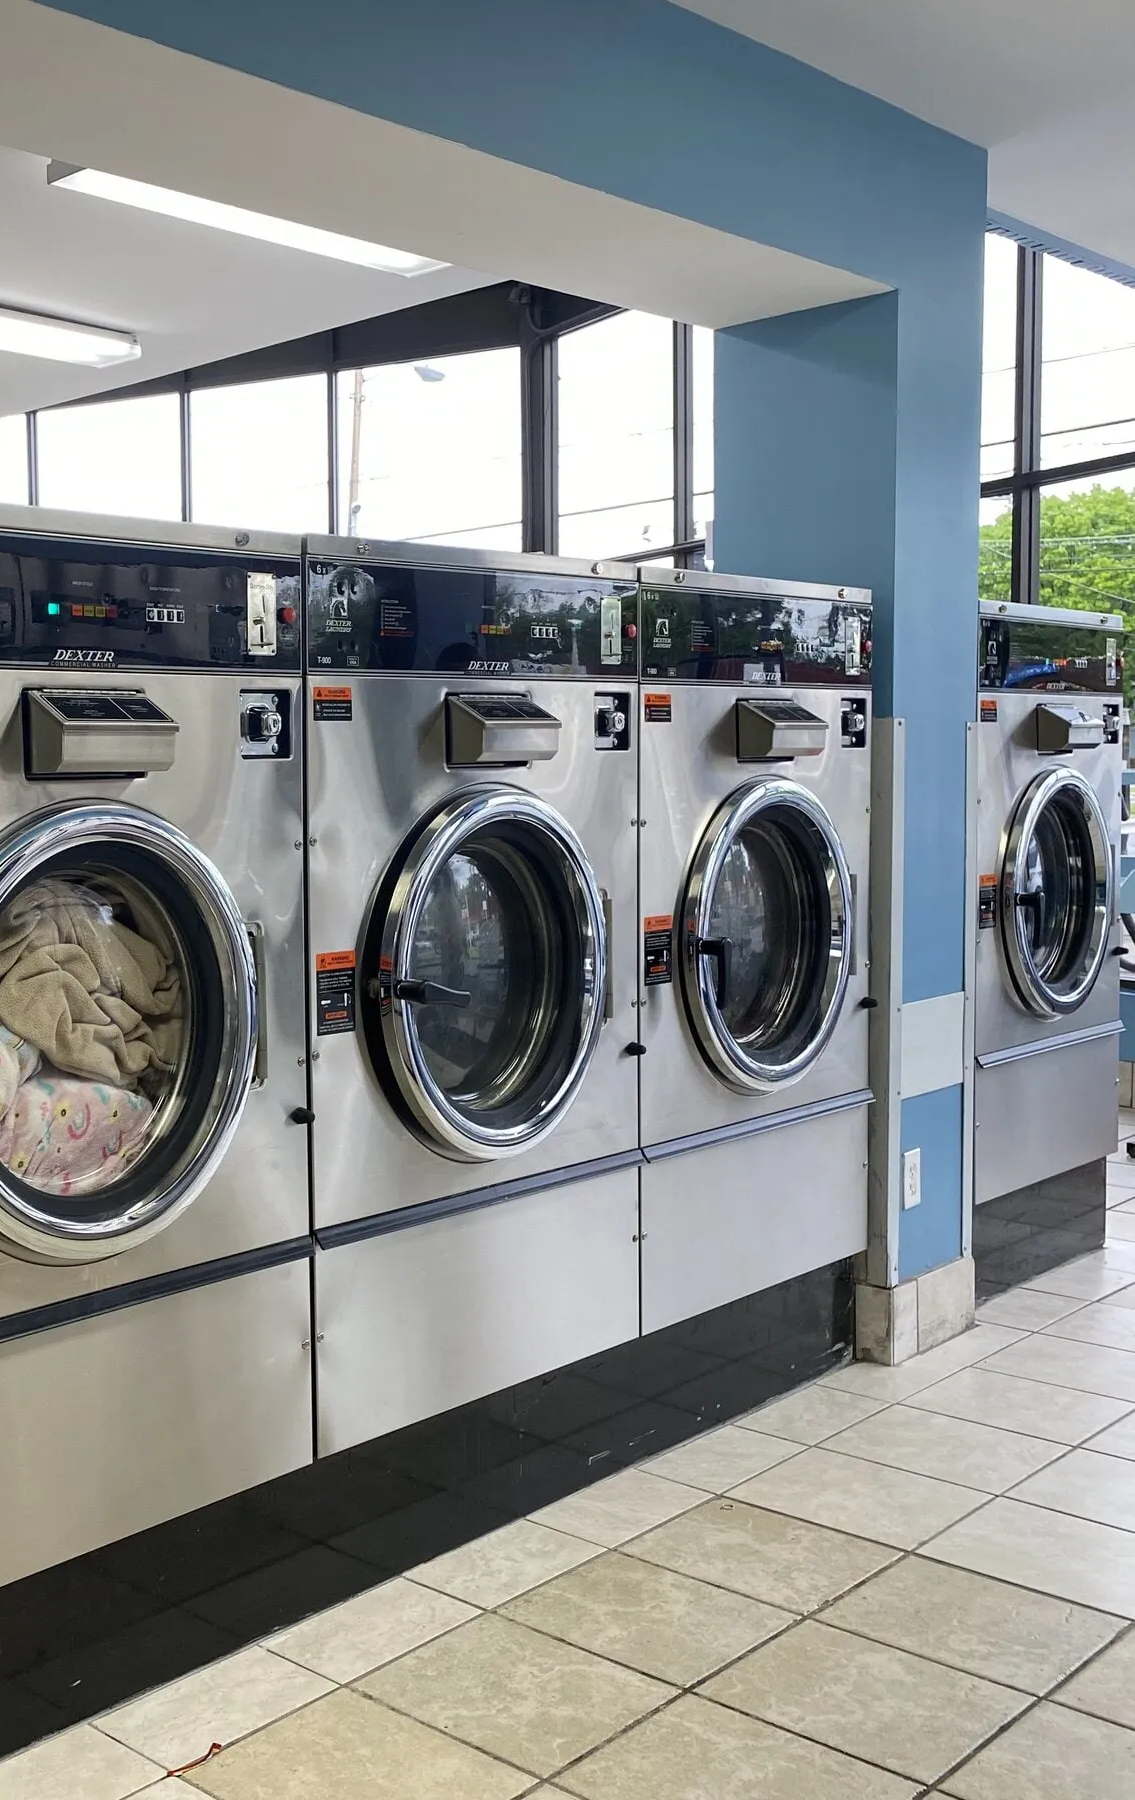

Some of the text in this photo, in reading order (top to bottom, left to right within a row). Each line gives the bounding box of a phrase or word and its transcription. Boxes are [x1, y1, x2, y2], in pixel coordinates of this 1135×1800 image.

[316, 564, 322, 574] 6
[53, 649, 115, 662] DEXTER
[467, 660, 509, 671] DEXTER
[751, 671, 781, 681] DEXTER
